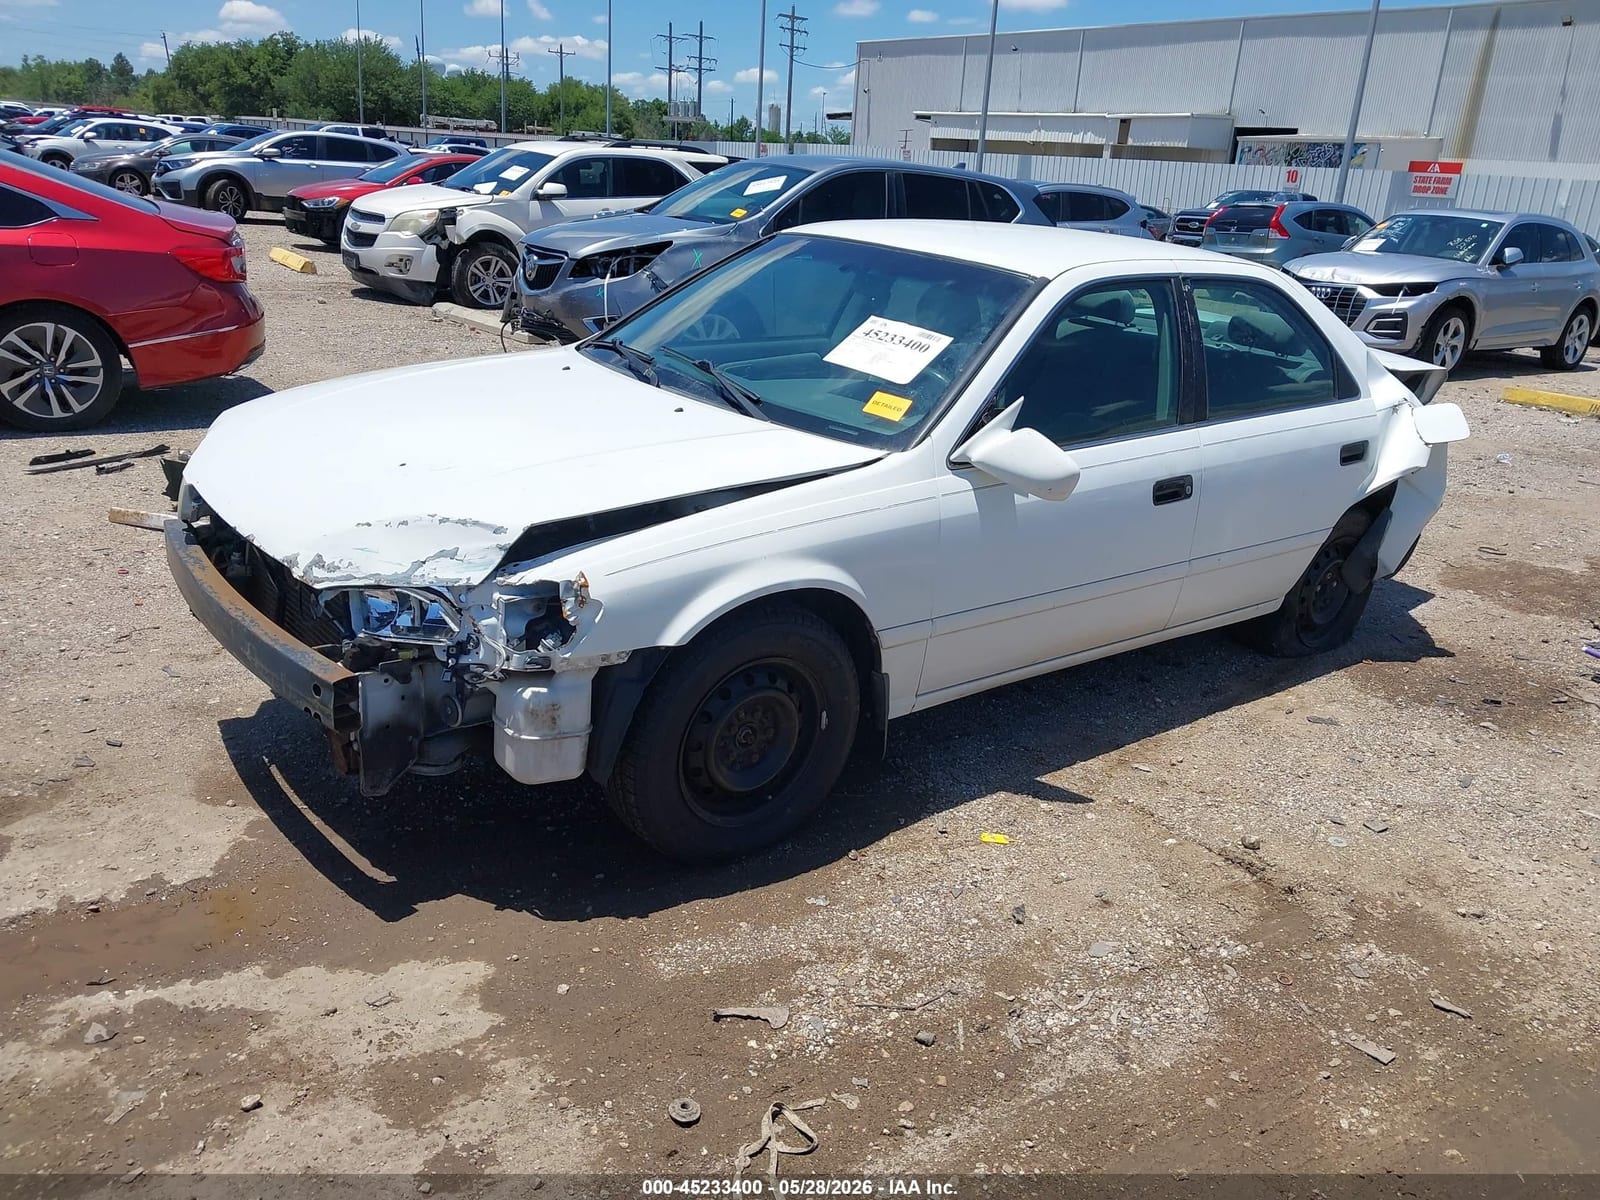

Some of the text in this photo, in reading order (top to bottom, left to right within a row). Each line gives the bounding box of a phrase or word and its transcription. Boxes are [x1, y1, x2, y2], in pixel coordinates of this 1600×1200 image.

[1286, 169, 1299, 184] 10
[1413, 175, 1452, 185] STATE FARM
[1412, 185, 1448, 195] DROP ZONE
[863, 328, 931, 353] 45233400
